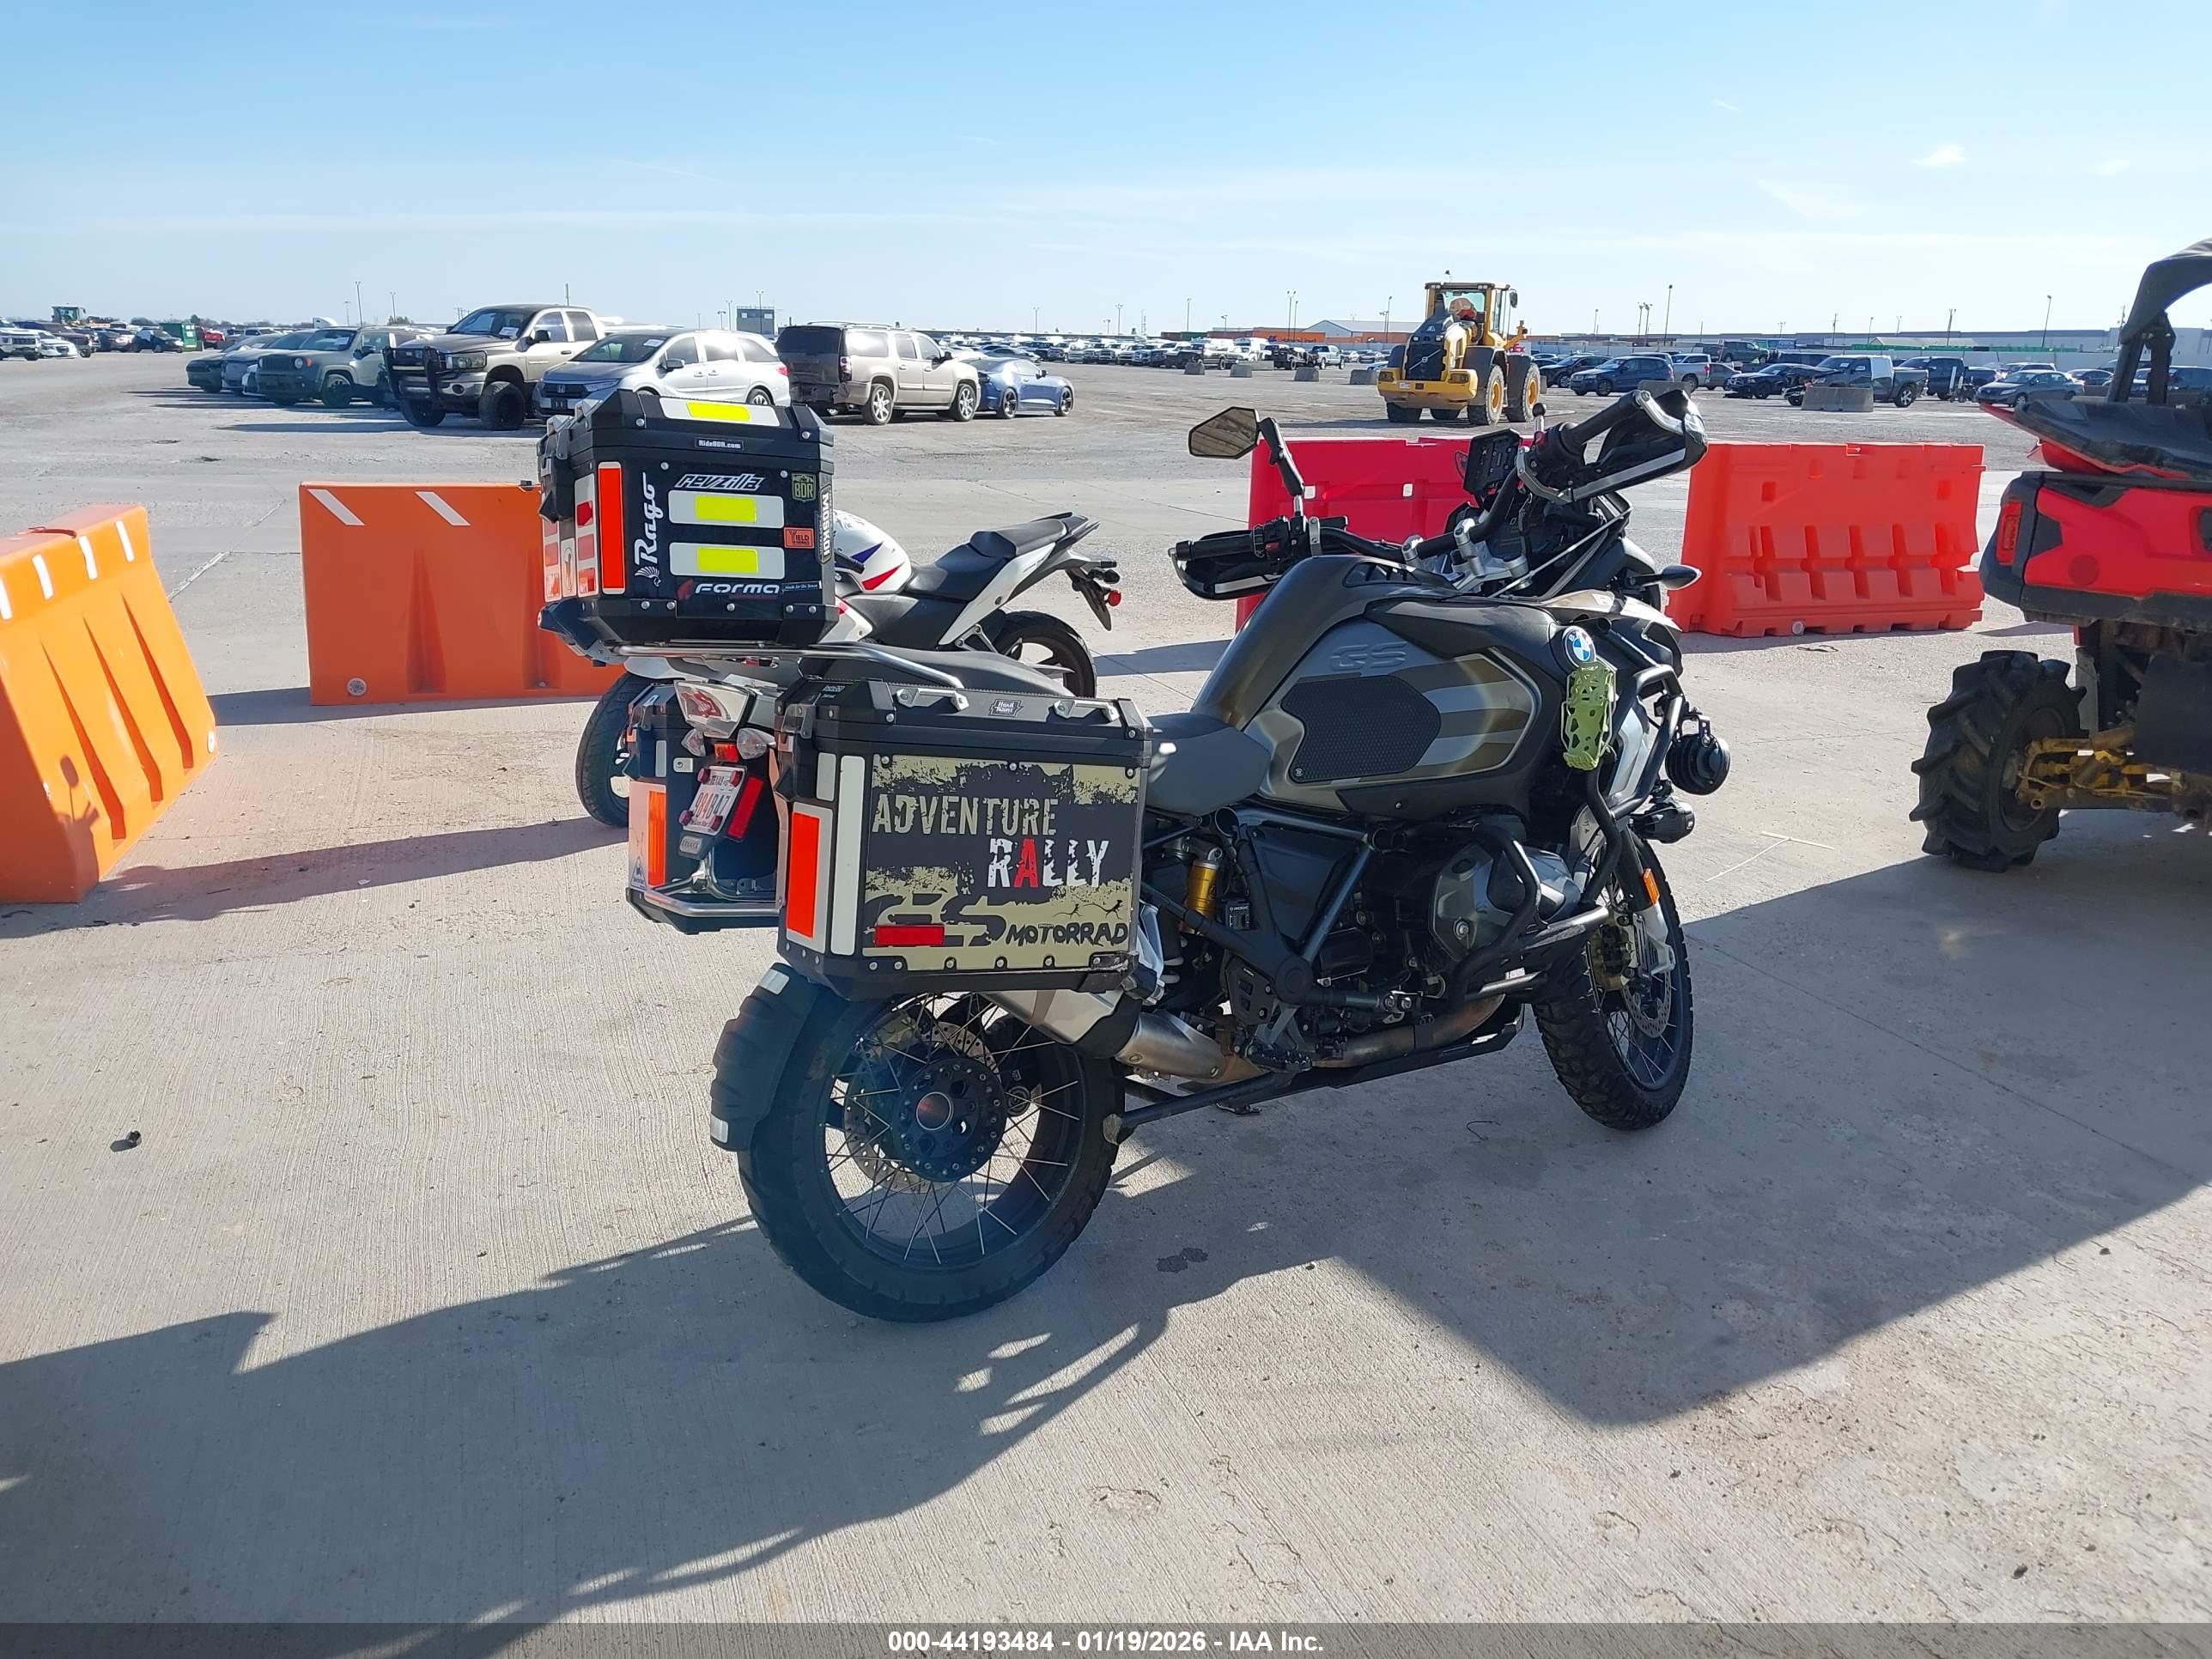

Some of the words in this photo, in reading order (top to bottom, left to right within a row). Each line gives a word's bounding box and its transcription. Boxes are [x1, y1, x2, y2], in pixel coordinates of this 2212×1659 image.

[794, 483, 814, 498] BDR
[1328, 641, 1407, 672] GS
[872, 793, 1059, 836] ADVENTURE
[988, 838, 1109, 888] RALLY
[1006, 921, 1129, 947] MOTORRAD
